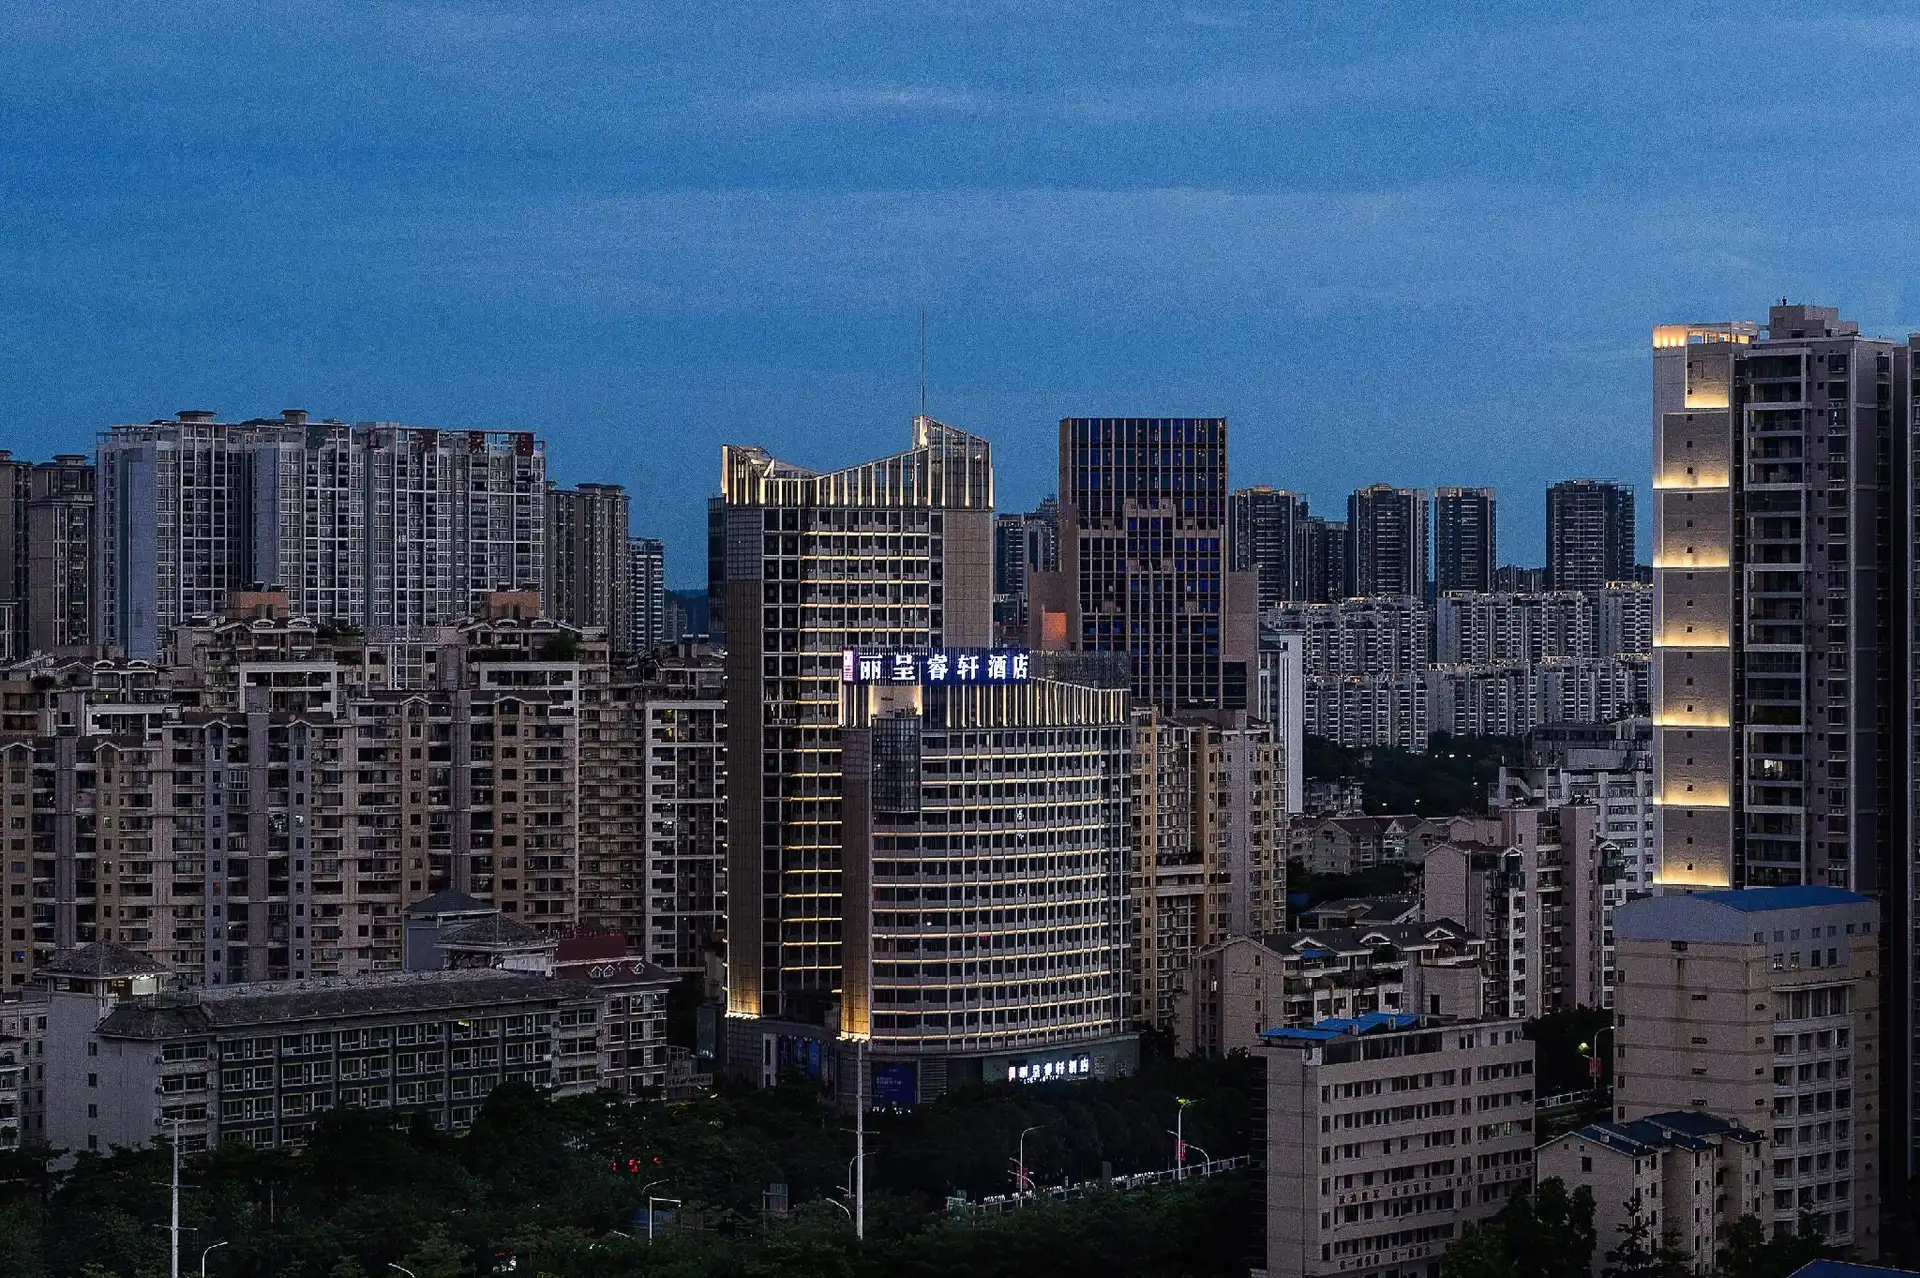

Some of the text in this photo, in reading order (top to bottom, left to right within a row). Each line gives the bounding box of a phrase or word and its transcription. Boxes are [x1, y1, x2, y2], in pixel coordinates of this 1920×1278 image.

[859, 653, 1029, 681] 丽呈睿轩酒店
